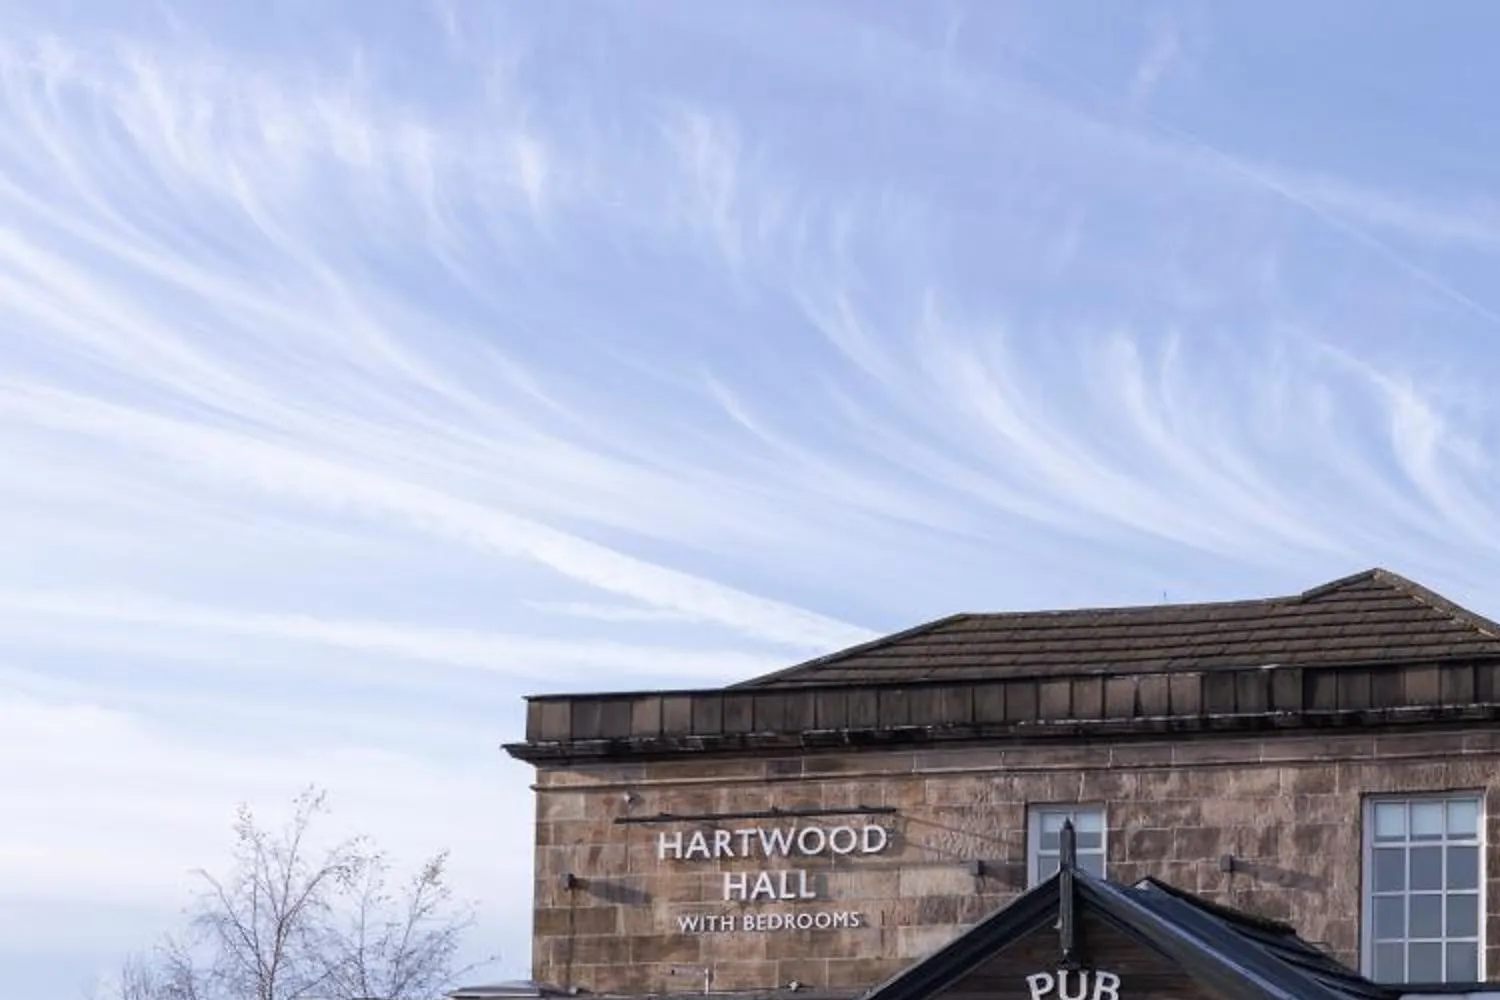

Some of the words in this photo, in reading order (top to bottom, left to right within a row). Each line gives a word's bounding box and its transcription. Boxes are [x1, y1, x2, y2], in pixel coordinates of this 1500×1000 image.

[657, 824, 888, 860] HARTWOOD
[723, 868, 816, 900] HALL
[677, 914, 735, 933] WITH
[743, 911, 860, 931] BEDROOMS
